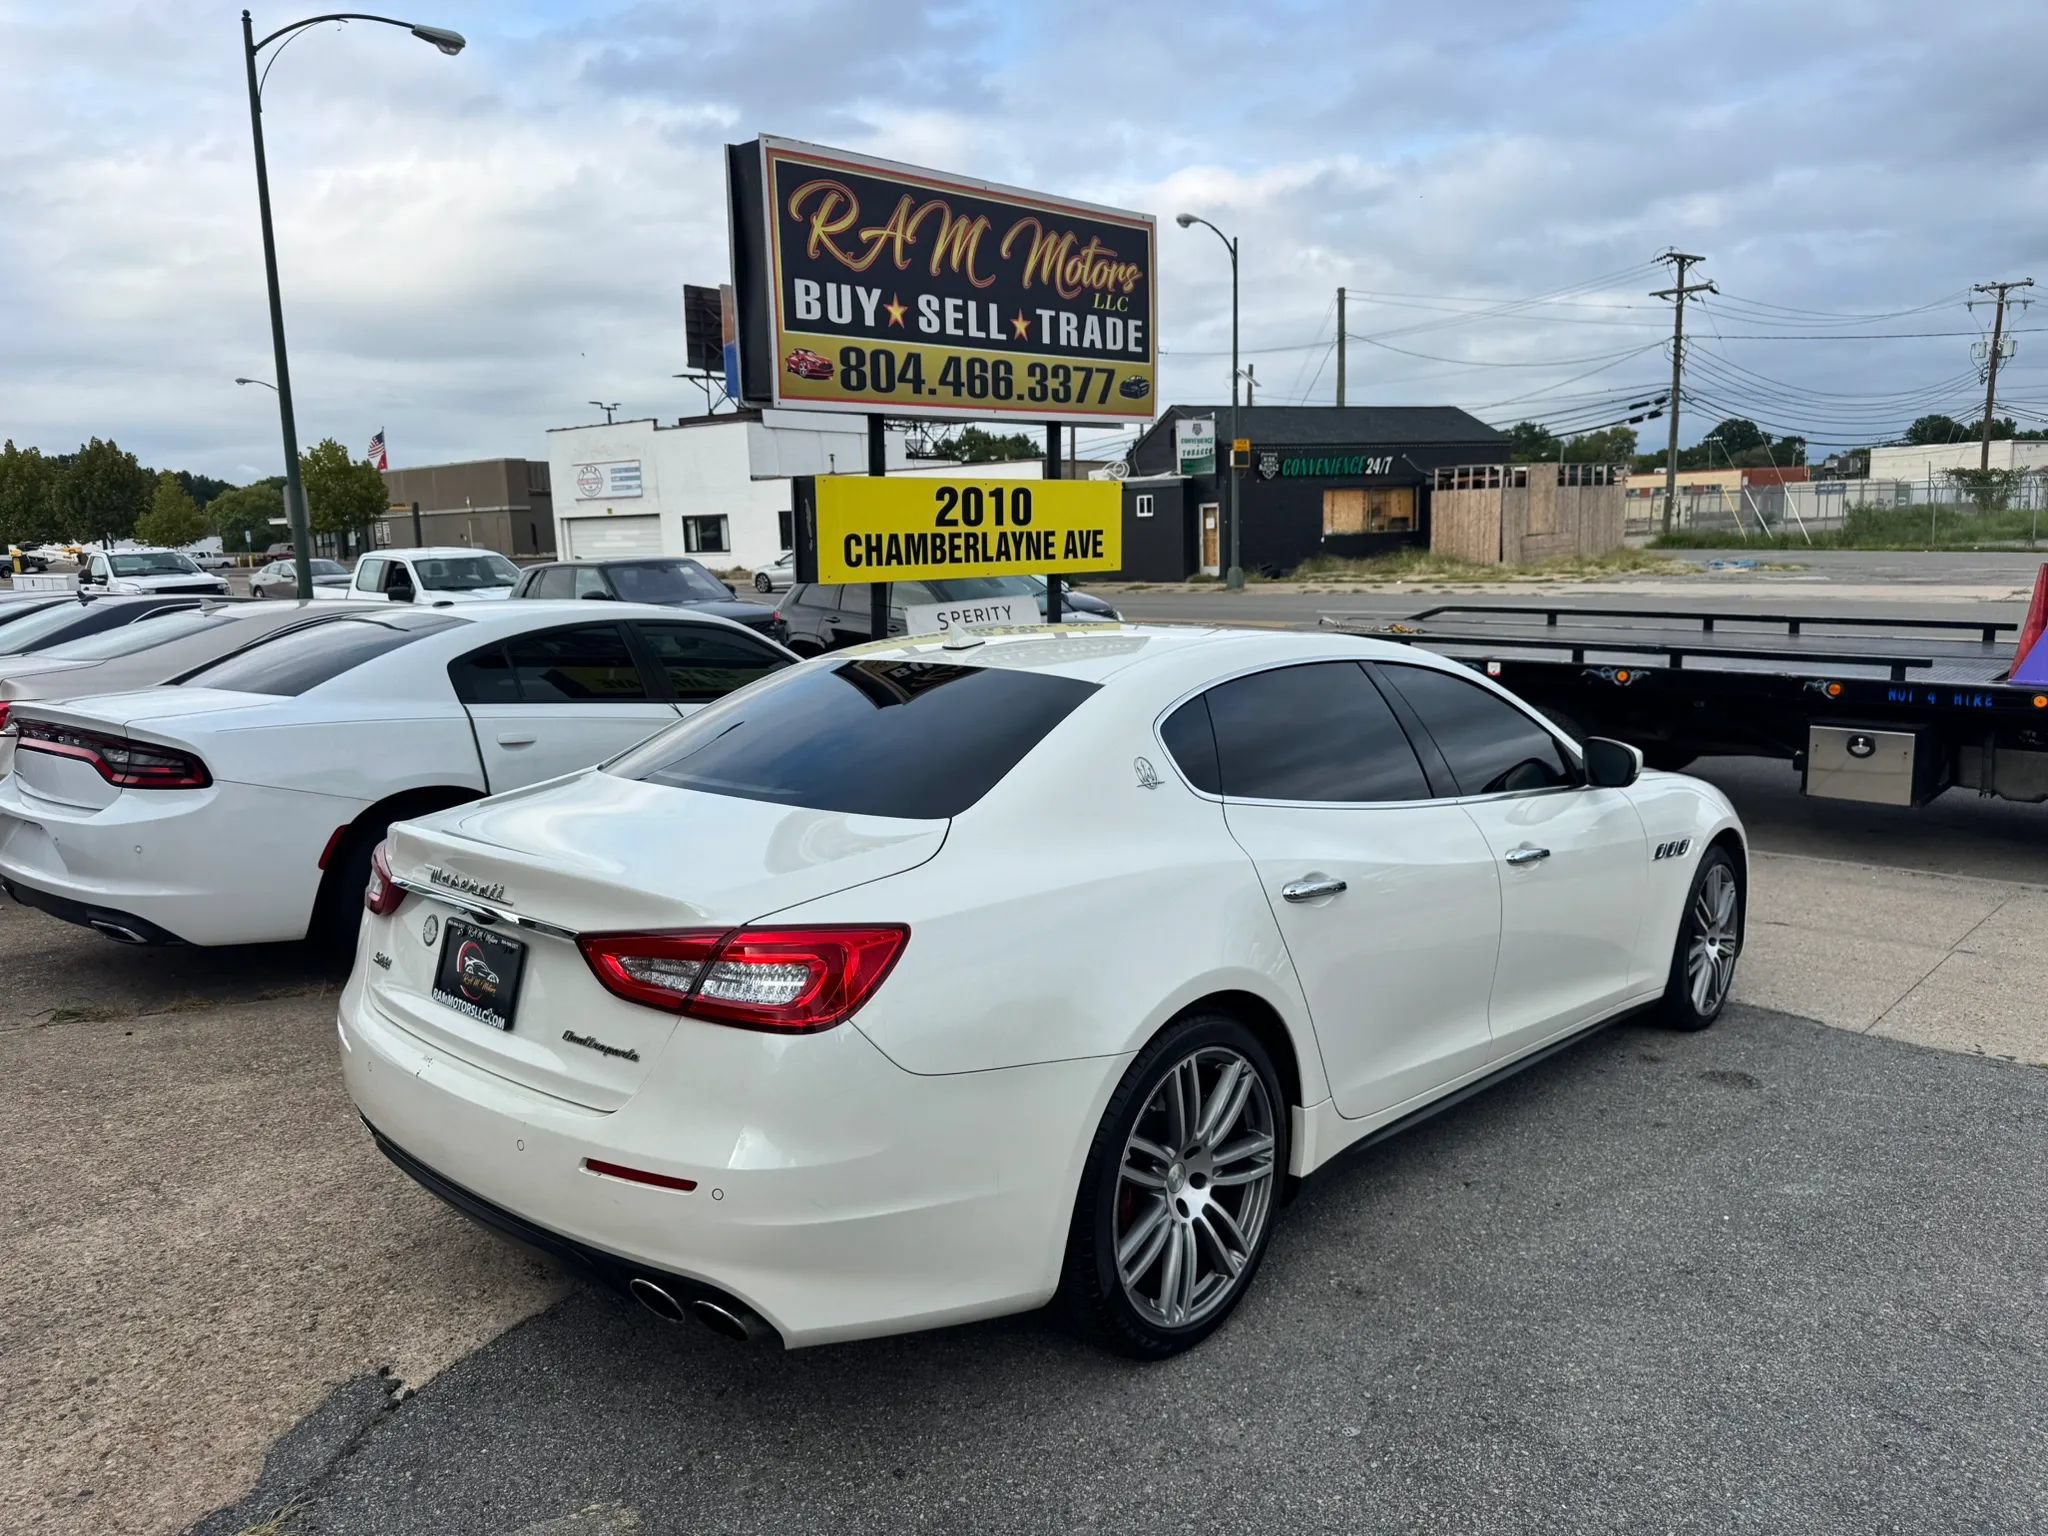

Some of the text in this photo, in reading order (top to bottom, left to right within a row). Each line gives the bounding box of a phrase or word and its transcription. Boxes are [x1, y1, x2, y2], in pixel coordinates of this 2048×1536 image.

[788, 179, 1143, 299] RAM Motors
[794, 278, 1143, 352] BUY SELL TRADE
[1093, 294, 1128, 312] LLC
[840, 346, 1116, 404] 804.466.3377
[1282, 456, 1367, 476] CONVENIENCE
[1365, 456, 1393, 475] 24/7
[935, 486, 1032, 527] 2010
[843, 529, 1104, 568] CHAMBERLAYNE AVE
[937, 605, 1011, 631] SPERITY
[432, 988, 505, 1030] RAMMOTORSLLC.COM
